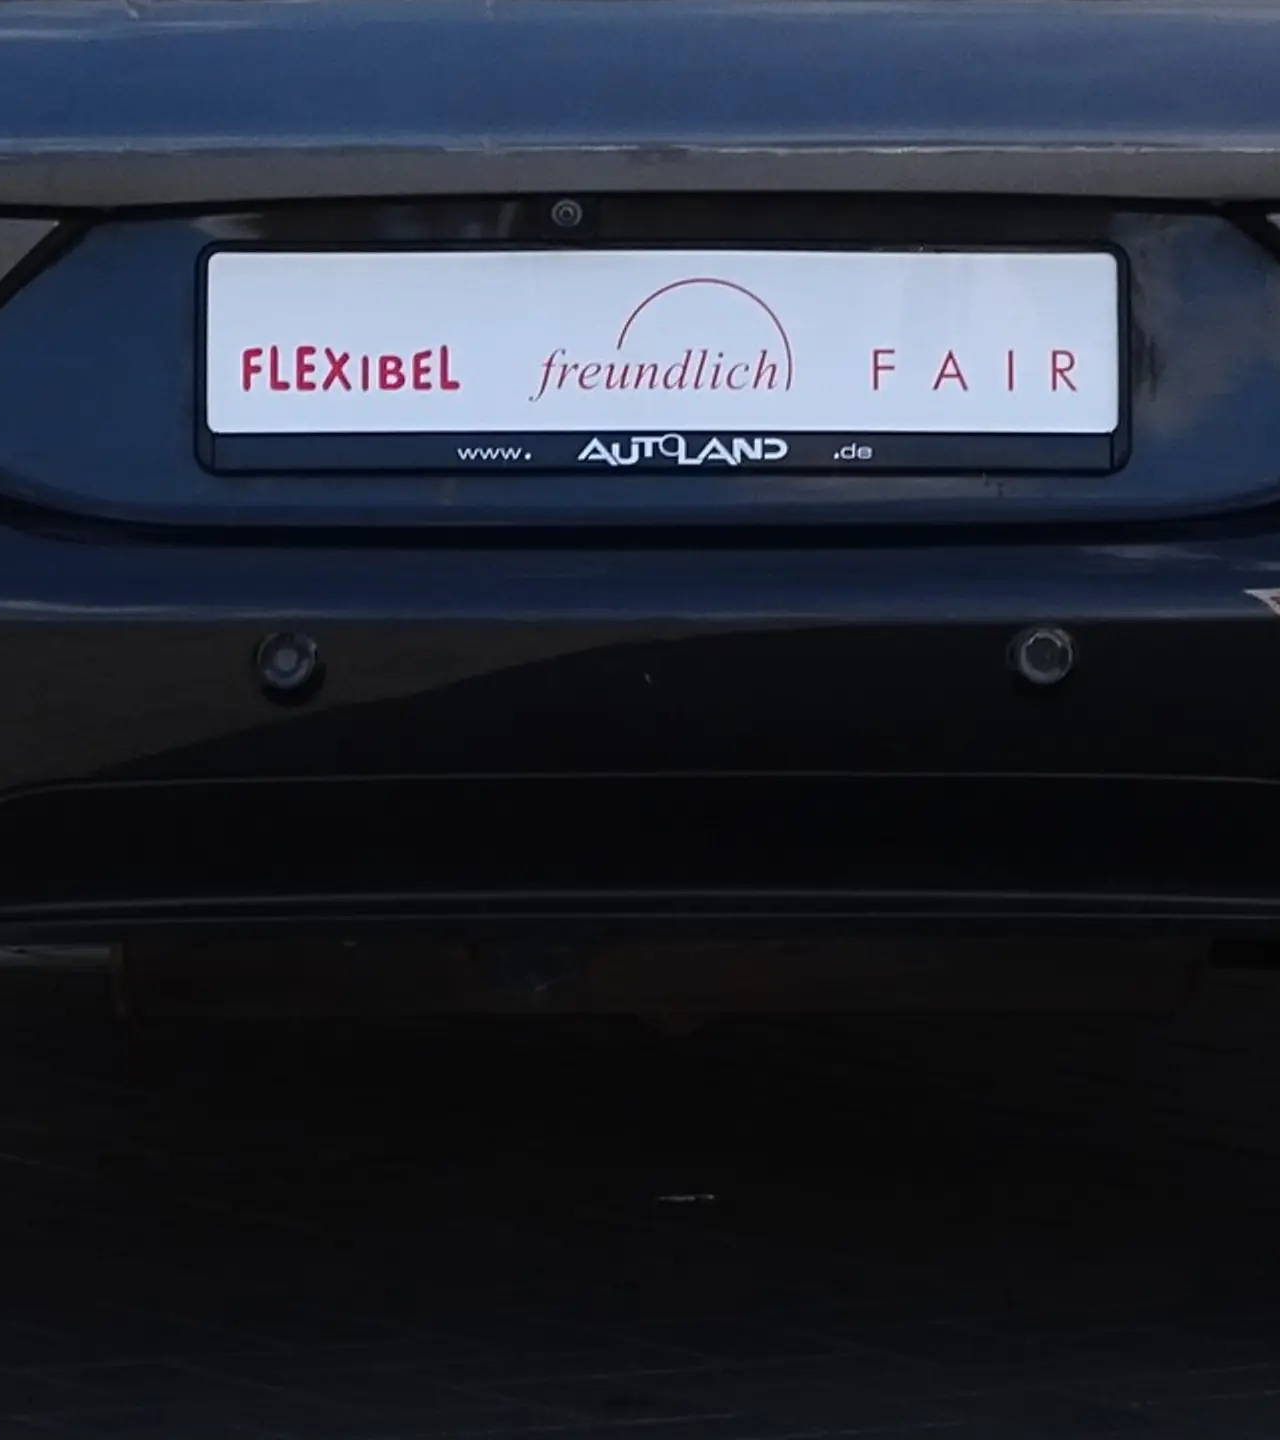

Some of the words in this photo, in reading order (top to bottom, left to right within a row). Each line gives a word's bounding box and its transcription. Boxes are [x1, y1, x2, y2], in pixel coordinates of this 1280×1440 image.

[241, 345, 461, 393] FLEXIBEL
[528, 346, 780, 403] freundlich
[456, 446, 532, 461] www.
[577, 434, 790, 467] AUTOLAND
